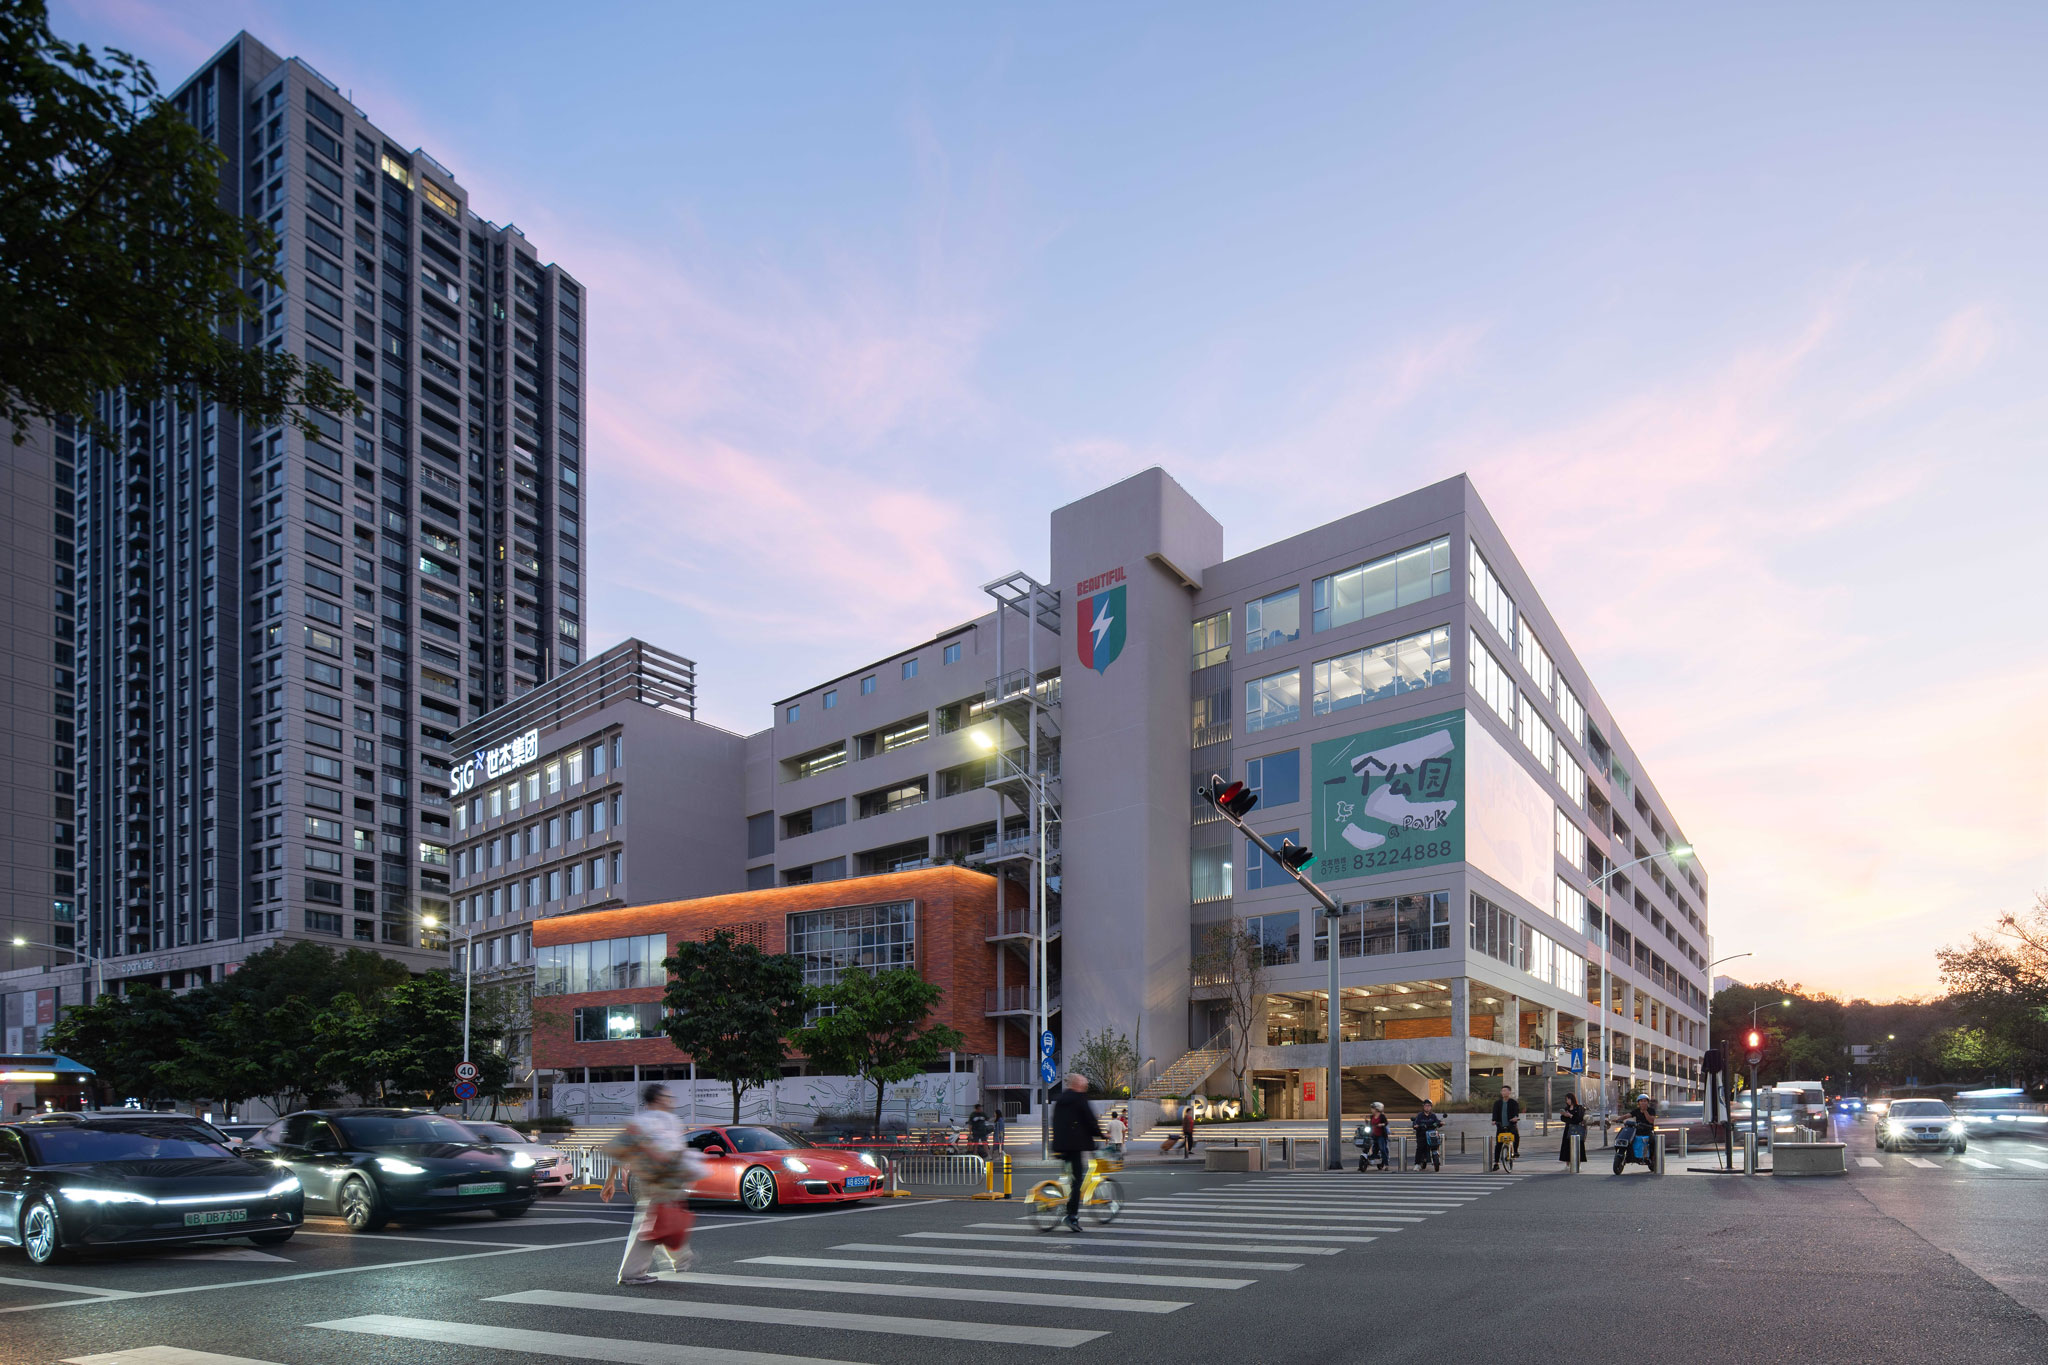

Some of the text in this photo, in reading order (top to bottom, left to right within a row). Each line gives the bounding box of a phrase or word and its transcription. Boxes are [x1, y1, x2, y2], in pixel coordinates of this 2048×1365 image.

[1077, 566, 1127, 596] BEAUTIFUL
[1324, 756, 1452, 798] 一个公园
[1353, 840, 1452, 870] 83224888
[1321, 864, 1347, 876] 0755
[460, 1066, 474, 1076] 40
[206, 1210, 246, 1223] DB7305
